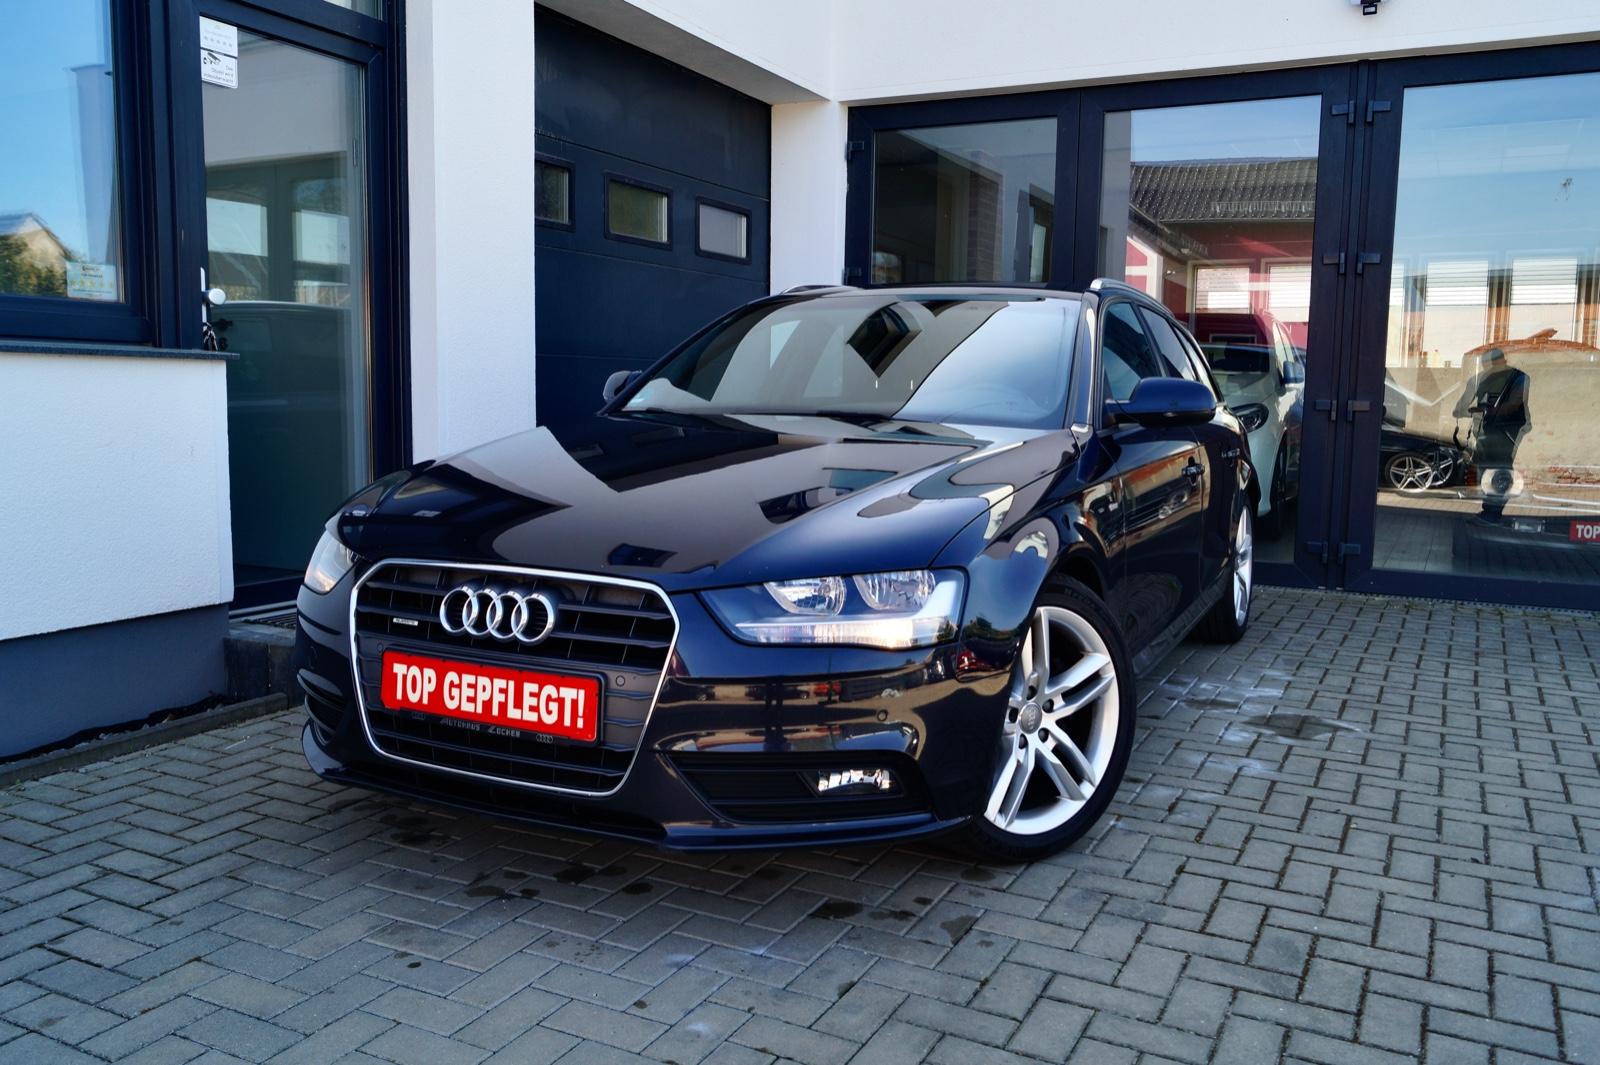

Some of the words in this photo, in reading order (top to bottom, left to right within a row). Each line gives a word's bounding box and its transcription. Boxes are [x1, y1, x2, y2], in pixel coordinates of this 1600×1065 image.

[1576, 524, 1600, 539] TOP
[393, 663, 437, 705] TOP
[443, 671, 586, 729] GEPFLEGT!
